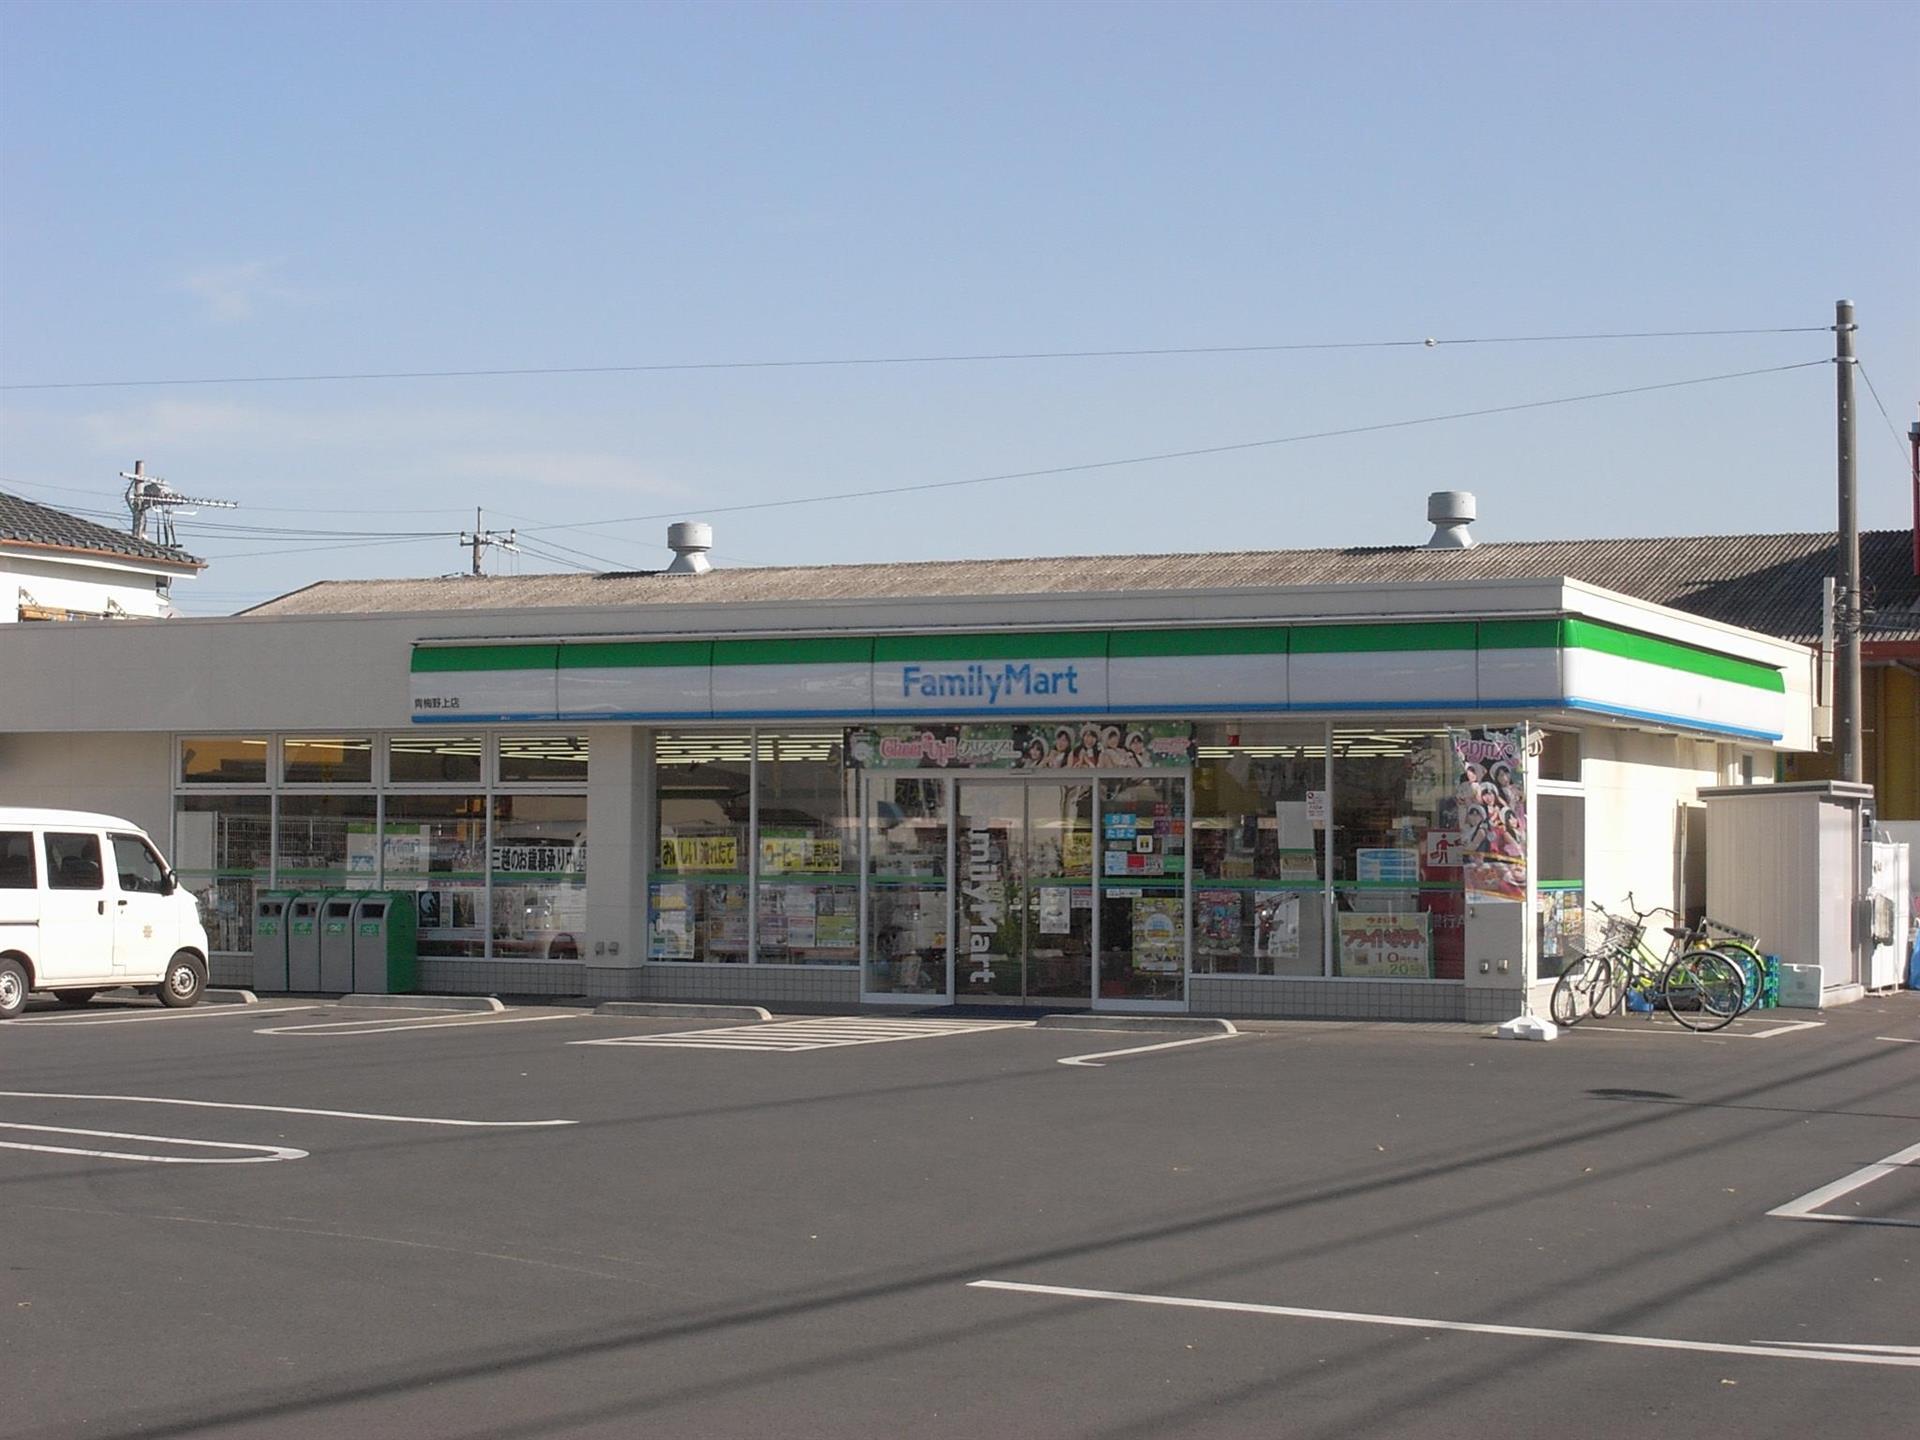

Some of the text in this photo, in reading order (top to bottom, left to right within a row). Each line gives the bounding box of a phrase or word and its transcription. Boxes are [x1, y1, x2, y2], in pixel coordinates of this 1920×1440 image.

[903, 664, 1079, 705] FamilyMart
[414, 697, 461, 710] 青梅野上店
